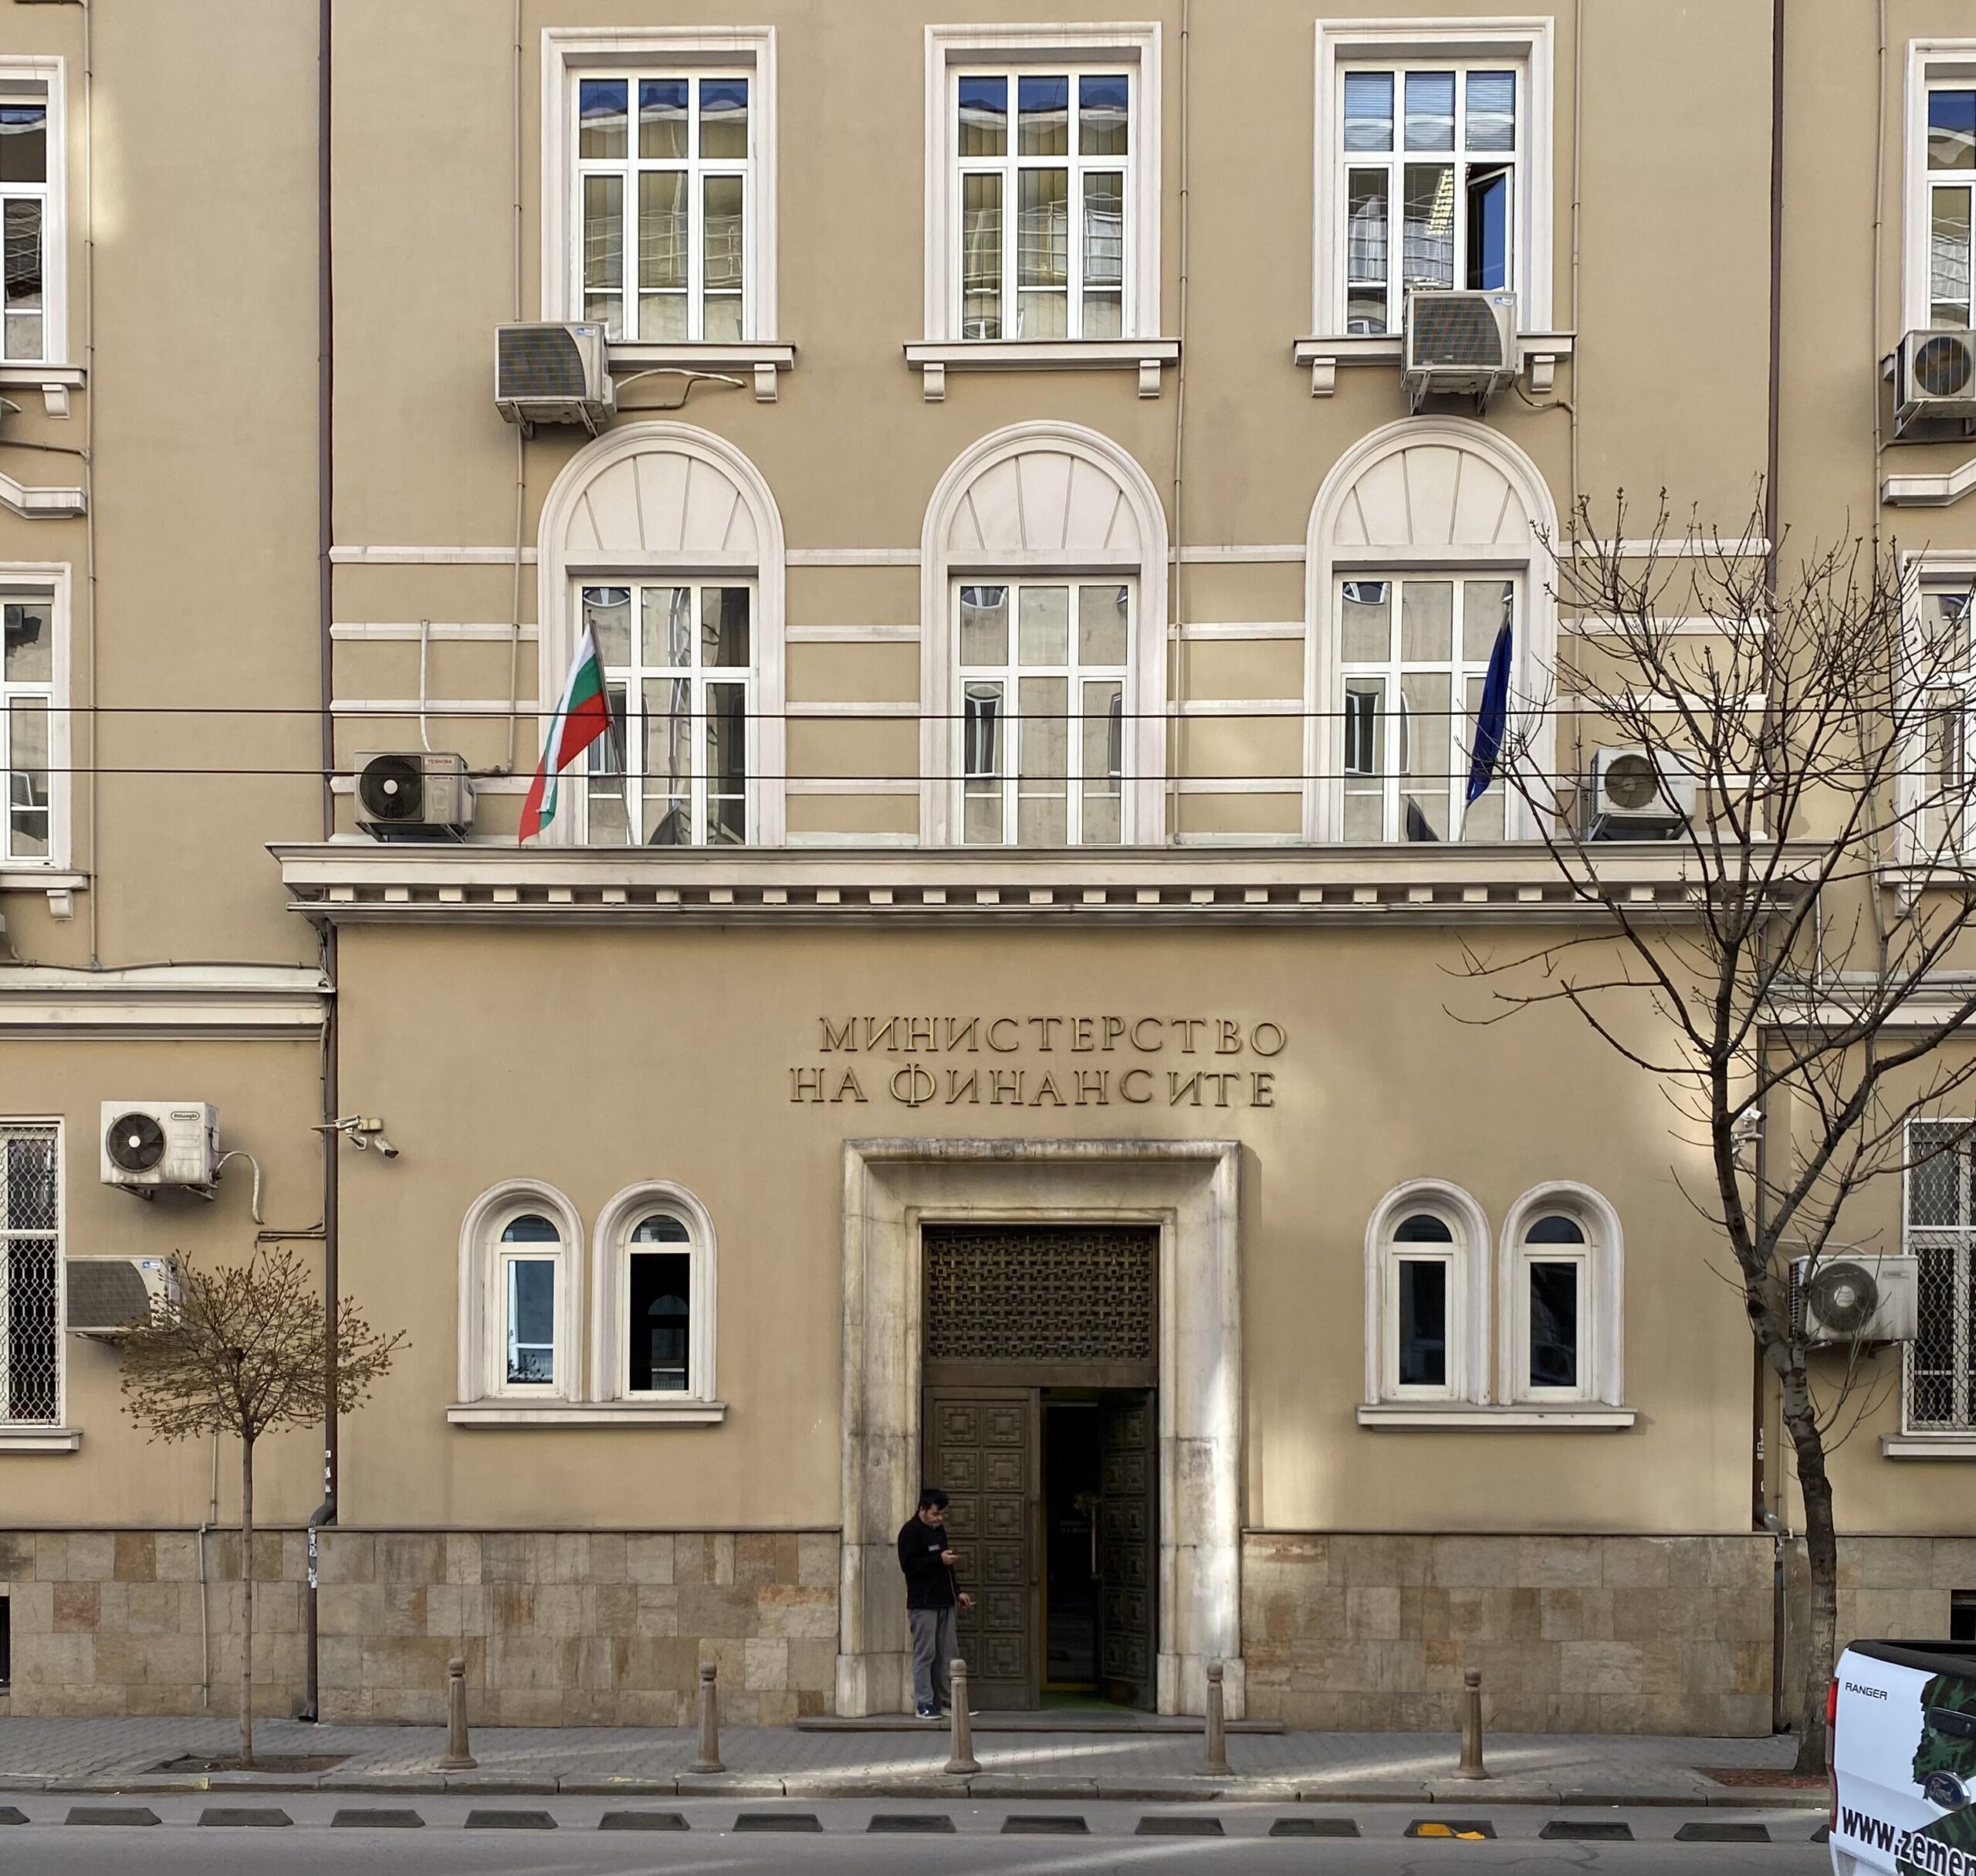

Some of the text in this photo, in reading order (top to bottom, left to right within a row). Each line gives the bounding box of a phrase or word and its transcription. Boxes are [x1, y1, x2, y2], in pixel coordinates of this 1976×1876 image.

[820, 1016, 1286, 1057] МИНИСТЕРСТВО
[790, 1062, 1275, 1107] НА ФИНАНСИТЕ
[1845, 1681, 1888, 1701] RANGER
